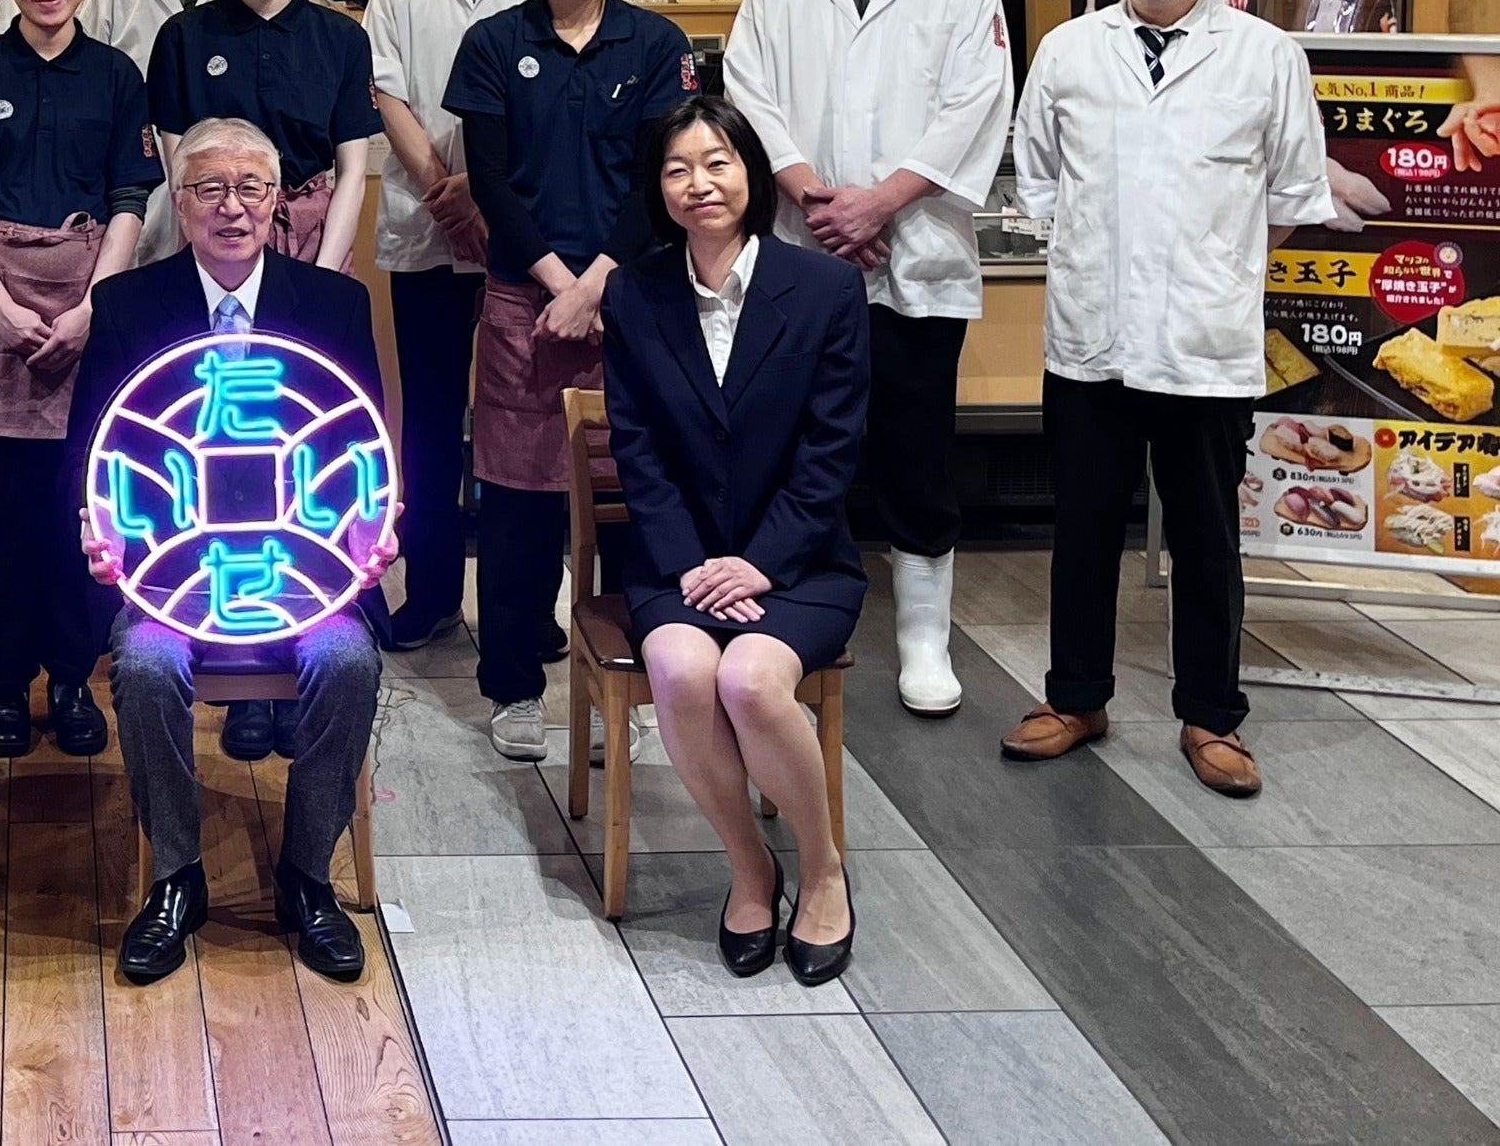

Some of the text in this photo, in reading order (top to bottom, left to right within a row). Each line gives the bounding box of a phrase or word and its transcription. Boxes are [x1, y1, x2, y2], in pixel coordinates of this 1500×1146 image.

[1387, 147, 1448, 170] 180円
[1405, 184, 1500, 196] お客様に愛され続けて
[1268, 260, 1357, 288] き玉子
[1301, 323, 1362, 346] 180円
